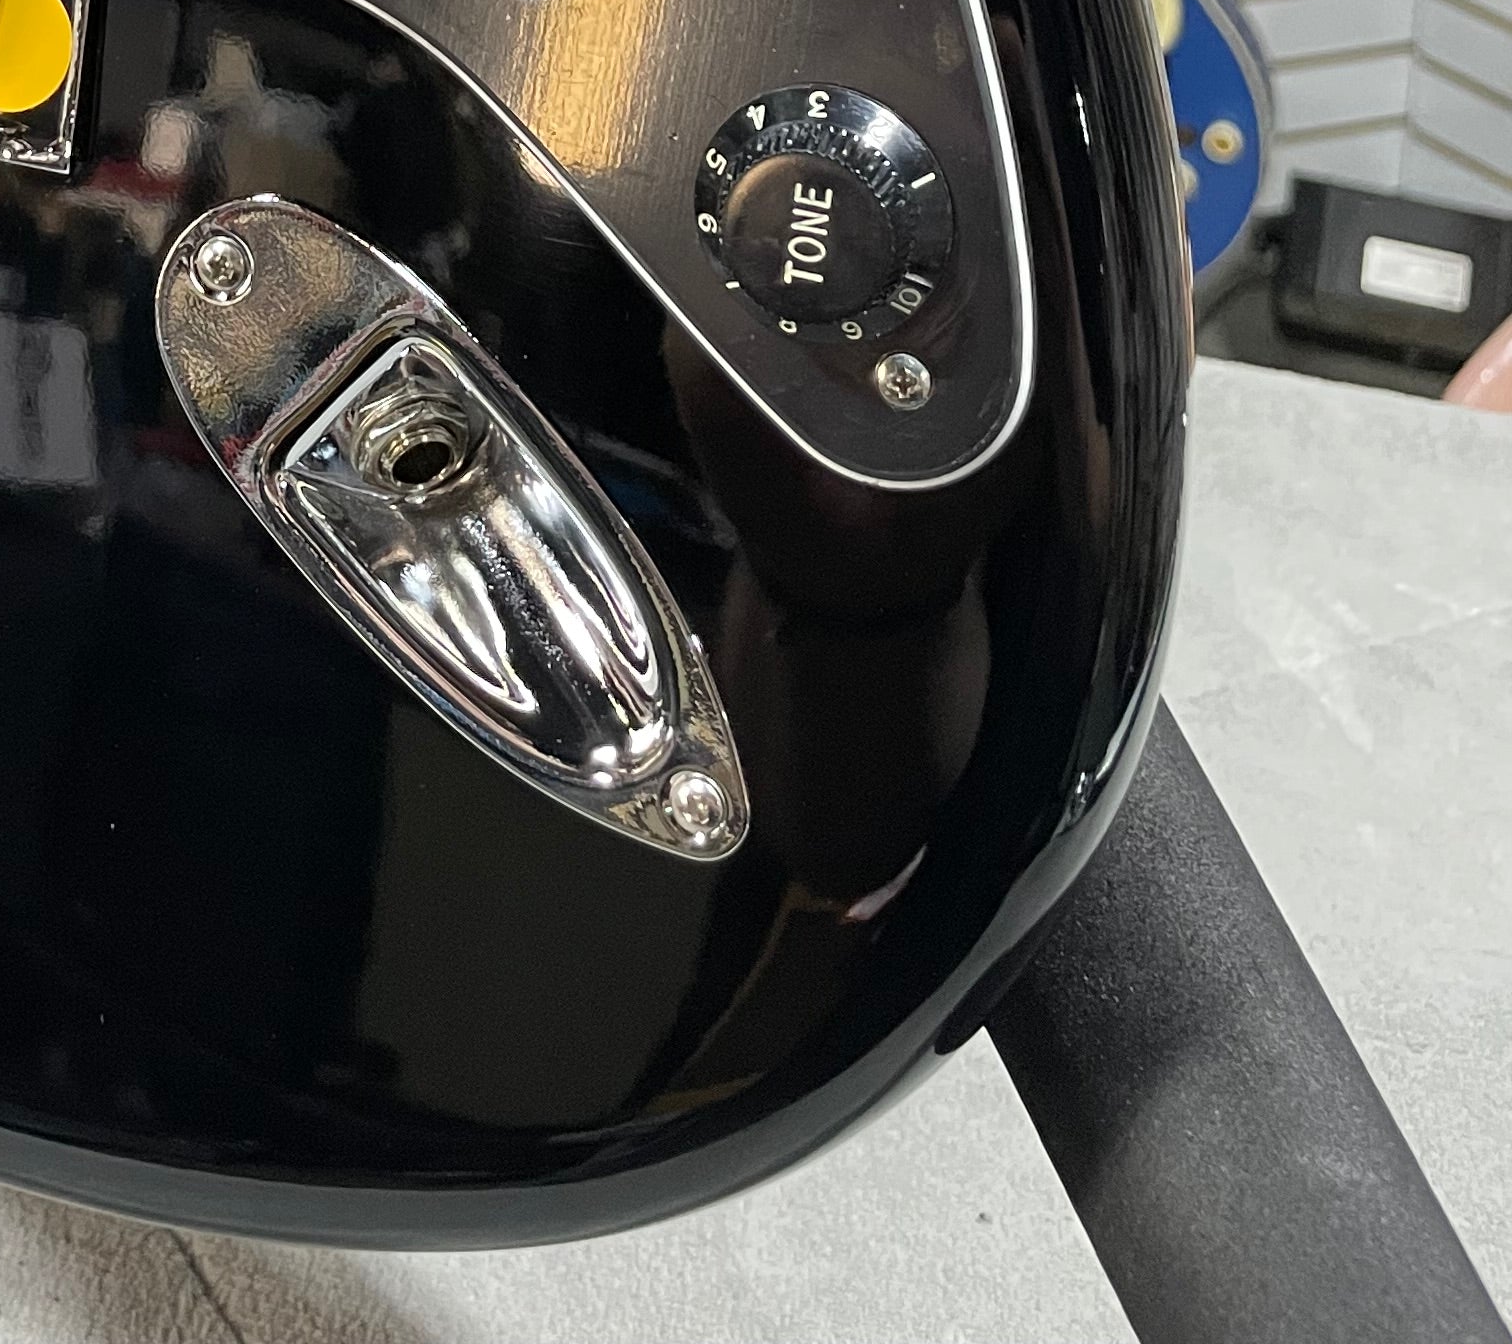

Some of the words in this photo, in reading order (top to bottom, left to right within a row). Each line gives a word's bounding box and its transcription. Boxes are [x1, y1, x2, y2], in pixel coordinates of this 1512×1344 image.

[746, 104, 766, 132] 4
[807, 90, 830, 120] 3
[705, 147, 728, 176] 5
[783, 182, 834, 285] TONE
